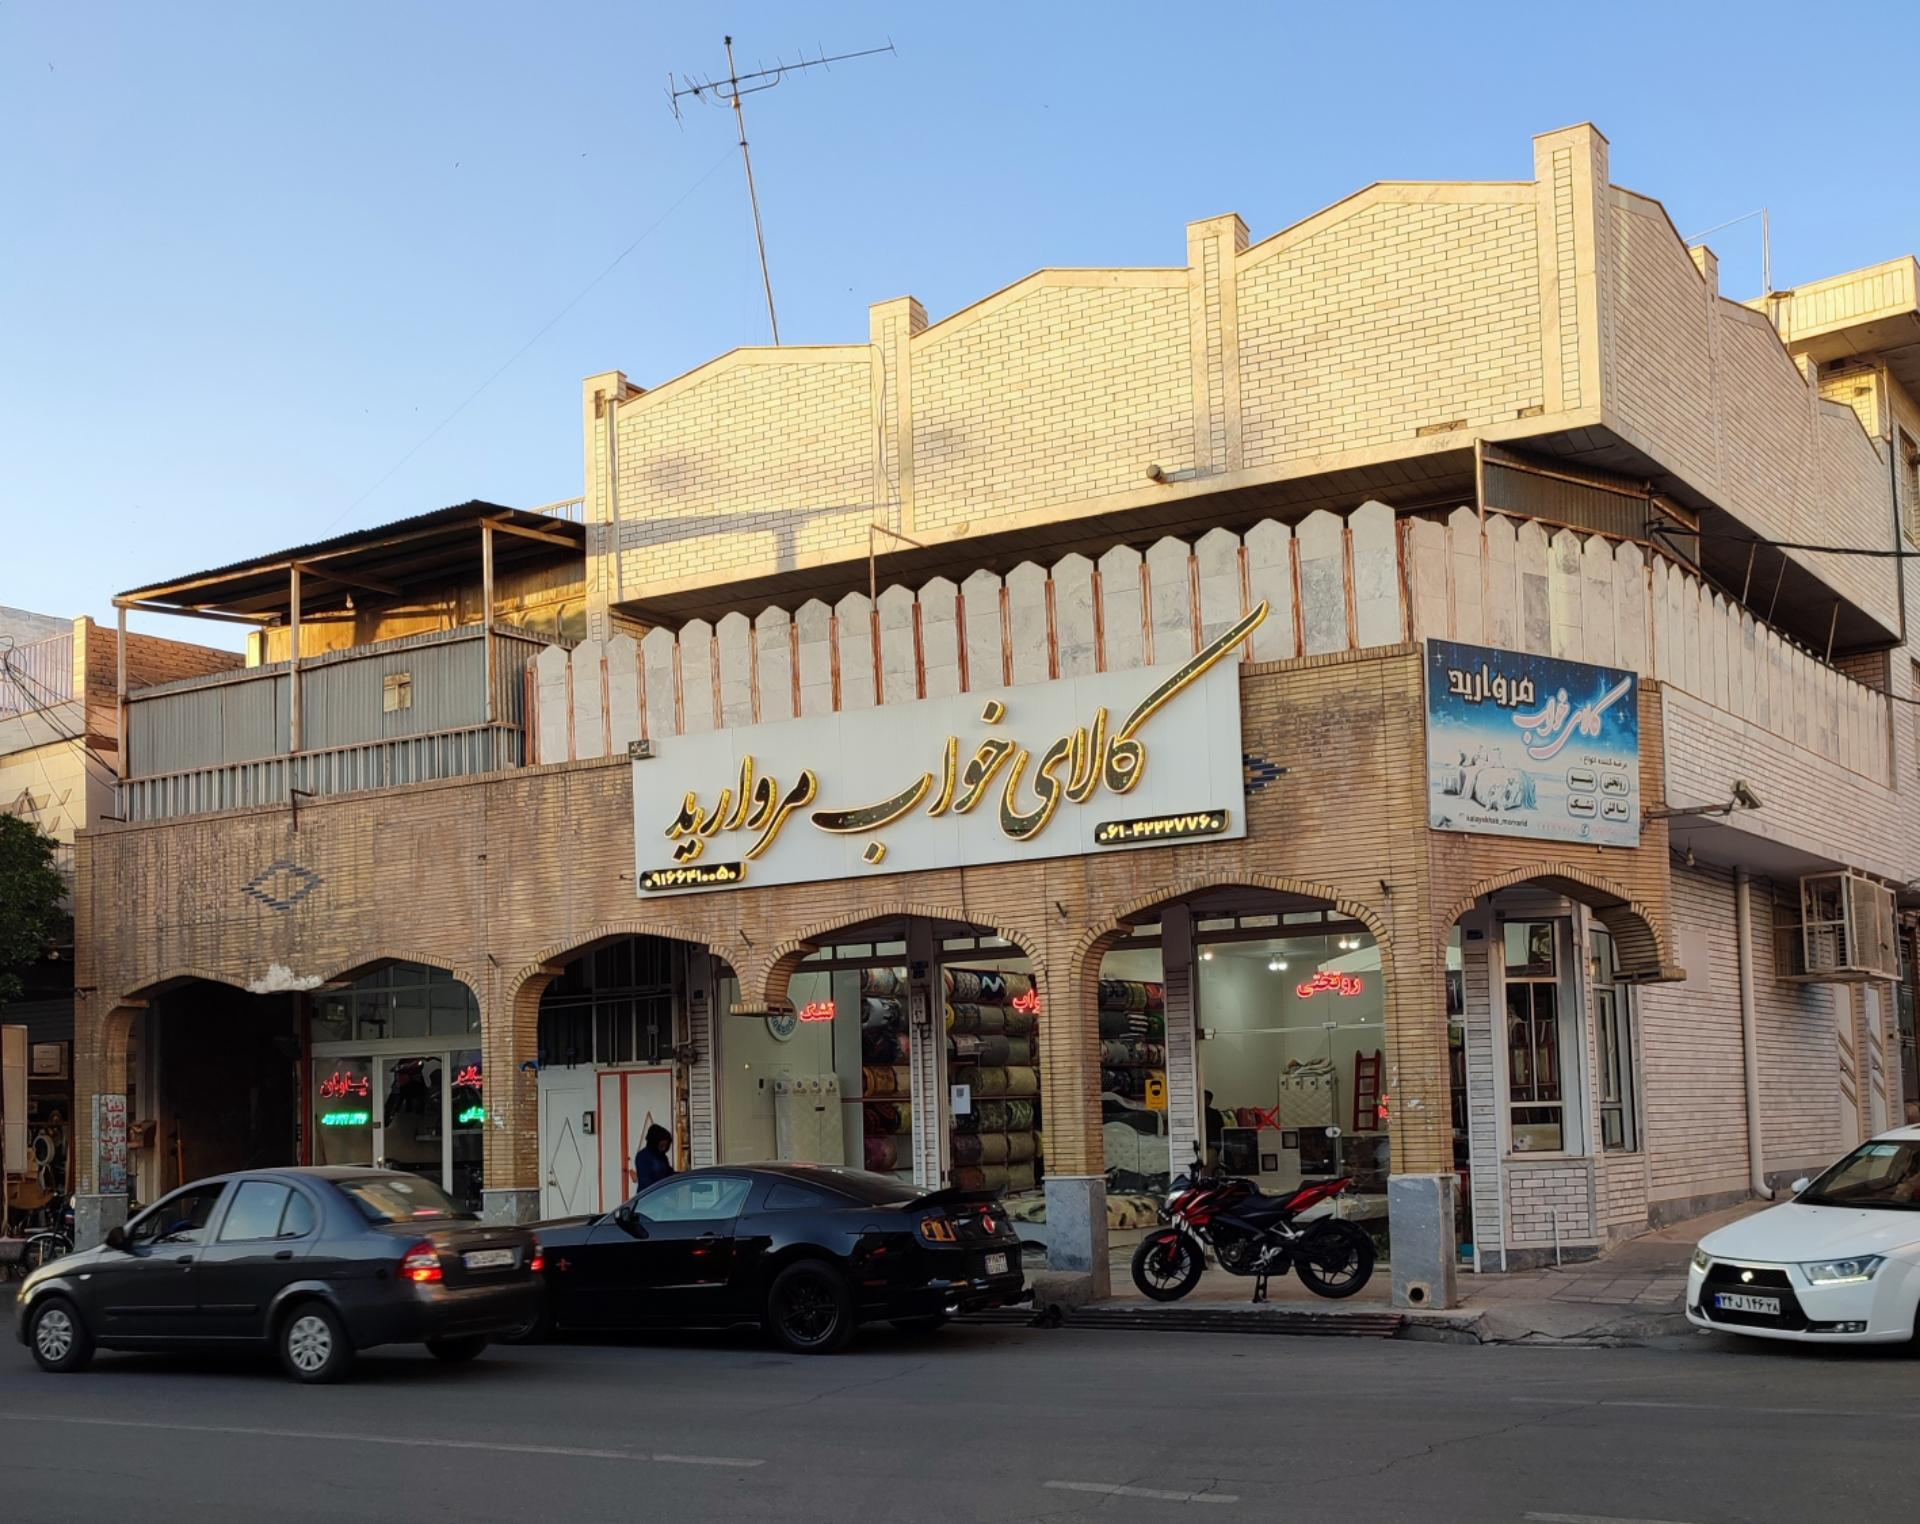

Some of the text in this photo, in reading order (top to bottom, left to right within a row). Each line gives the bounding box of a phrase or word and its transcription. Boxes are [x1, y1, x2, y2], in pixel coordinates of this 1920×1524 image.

[1448, 664, 1535, 706] مروارید
[664, 600, 1270, 864] کالای خواب مروارید
[1570, 799, 1594, 812] تشک
[1604, 801, 1627, 817] بالش
[645, 865, 737, 887] ۰۹۱۶۶۴۱۰۰۵۰
[1296, 971, 1363, 998] روتختی
[800, 1001, 835, 1022] تشک
